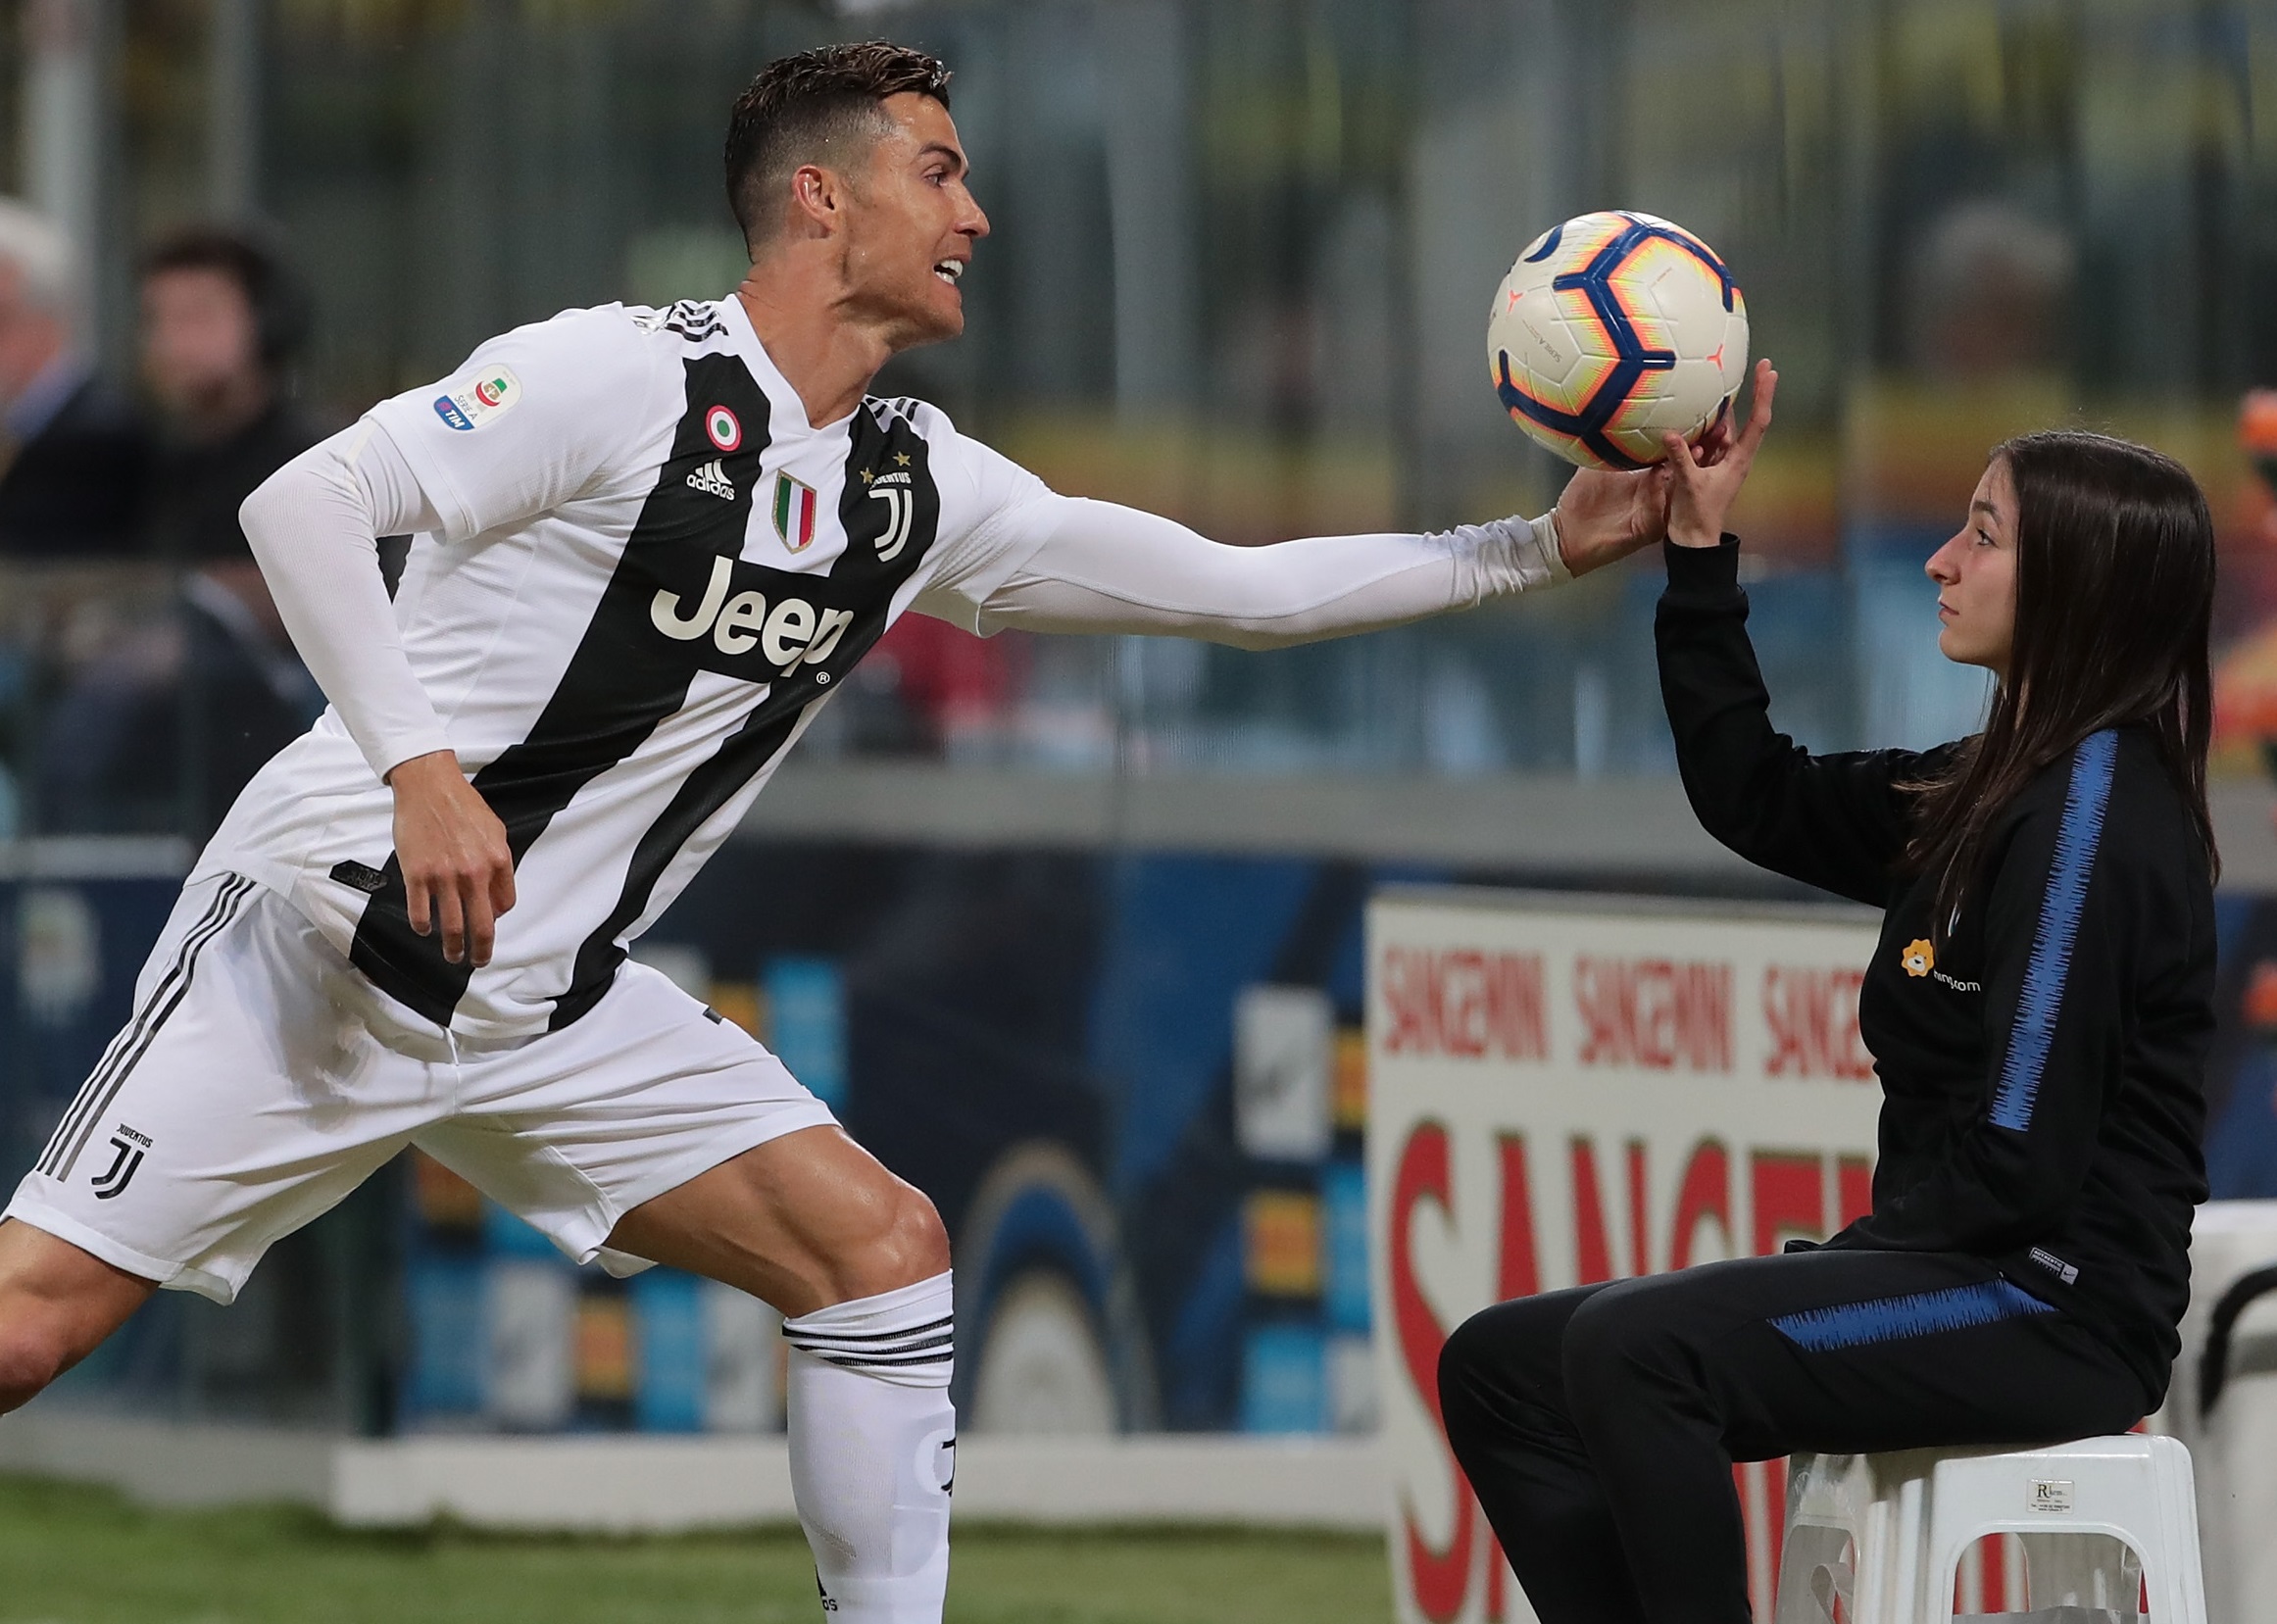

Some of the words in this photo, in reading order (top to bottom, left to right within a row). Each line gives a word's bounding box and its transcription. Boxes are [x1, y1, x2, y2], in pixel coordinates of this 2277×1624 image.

[445, 409, 466, 428] TIM
[686, 474, 735, 501] adidas
[650, 555, 855, 678] Jeep
[1767, 963, 1874, 1082] SANGE
[117, 1123, 154, 1149] JUVENTUS
